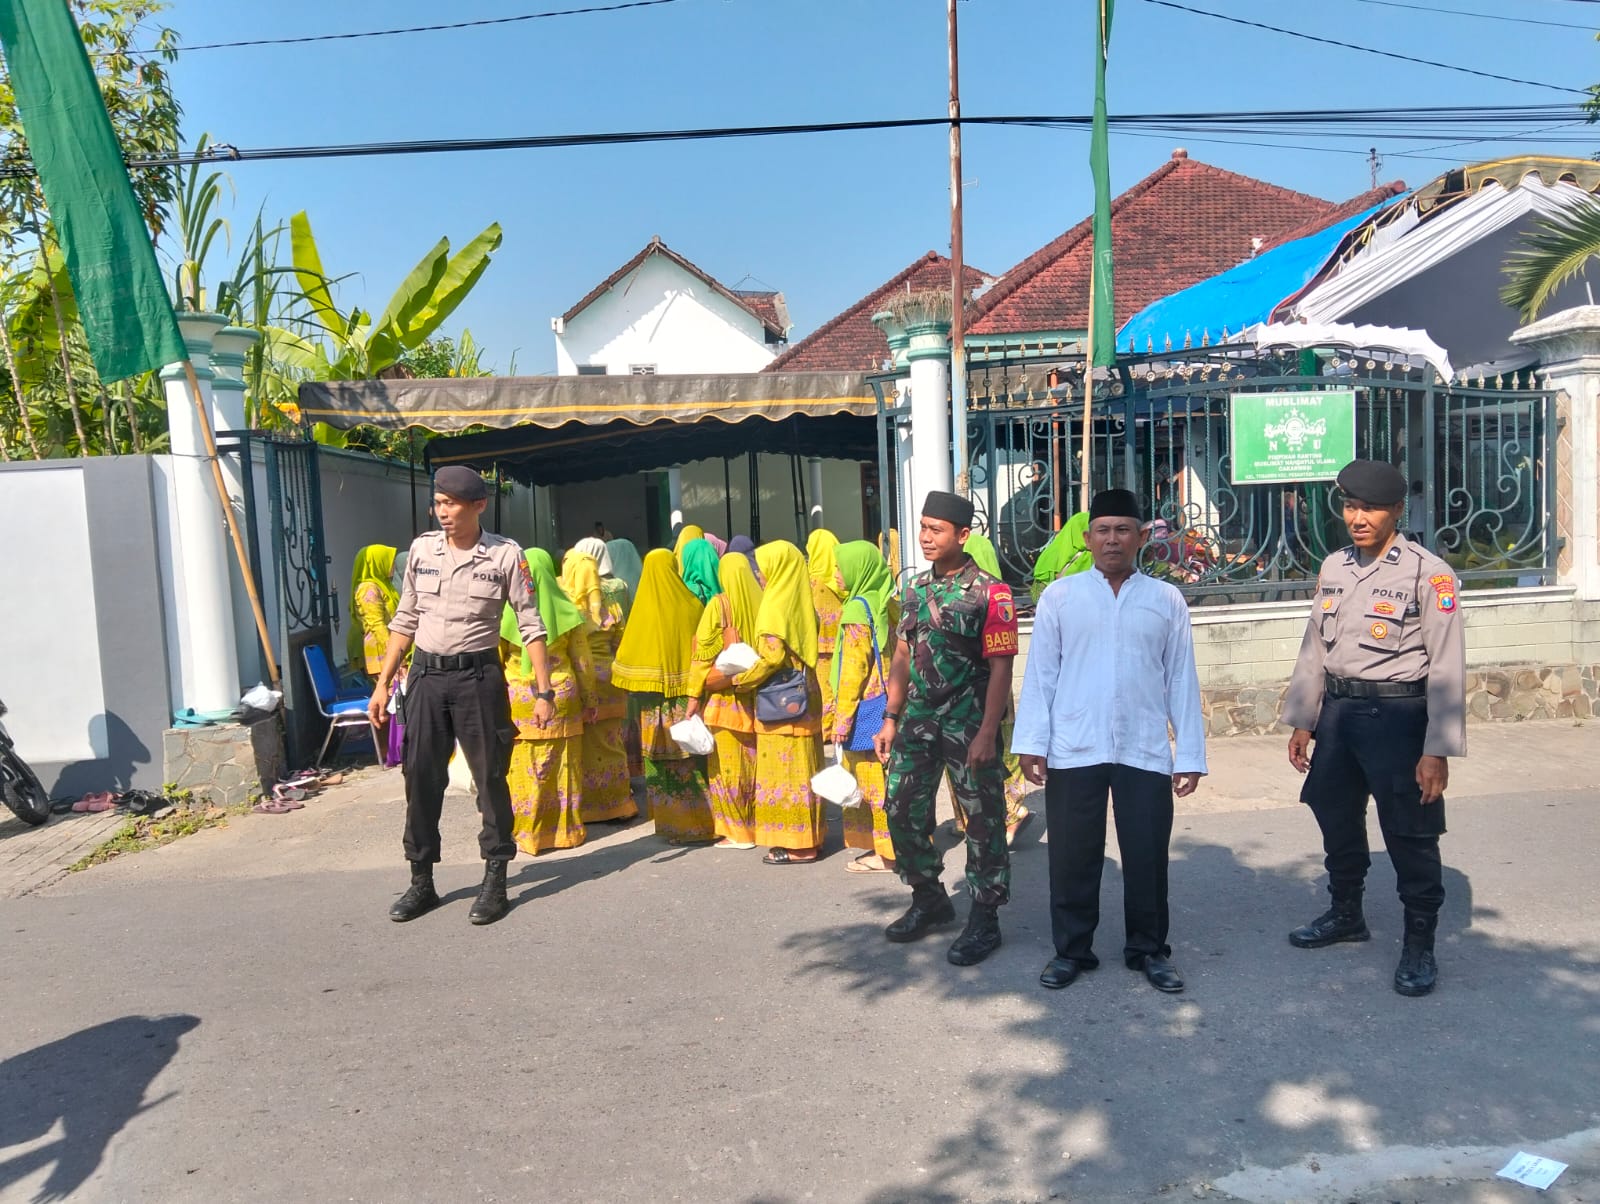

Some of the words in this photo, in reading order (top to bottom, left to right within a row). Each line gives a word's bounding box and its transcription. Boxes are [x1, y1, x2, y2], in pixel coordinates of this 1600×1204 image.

[1265, 396, 1324, 407] MUSLIMAT
[1269, 441, 1278, 451] N
[1313, 439, 1321, 450] U
[1372, 588, 1409, 601] POLRI
